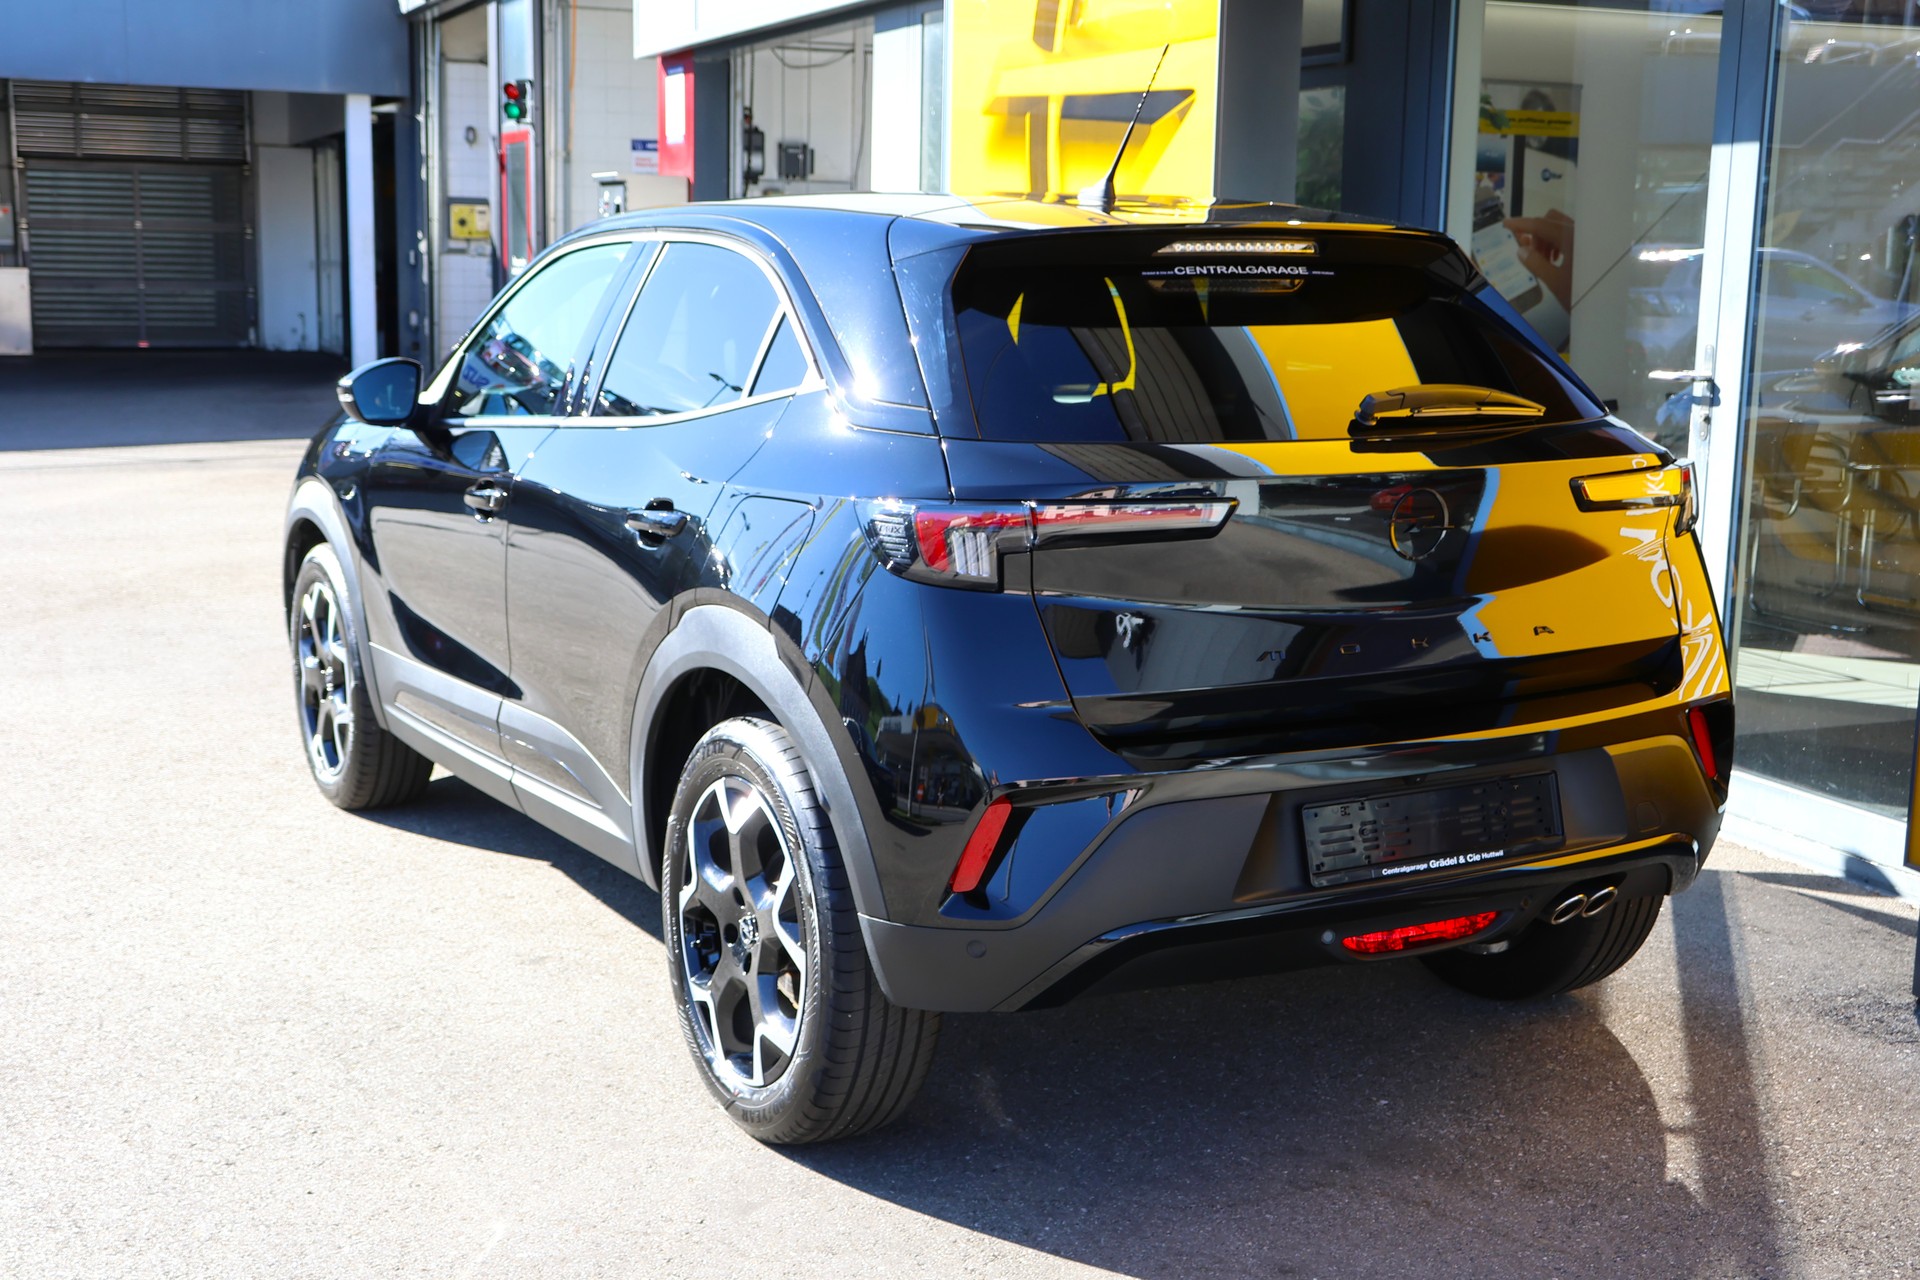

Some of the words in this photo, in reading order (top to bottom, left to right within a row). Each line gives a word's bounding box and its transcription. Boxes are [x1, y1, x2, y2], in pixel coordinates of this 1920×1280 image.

[1174, 265, 1309, 275] CENTRALGARAGE
[1256, 625, 1555, 663] MOKKA
[1381, 862, 1428, 876] Centralgarage
[1429, 856, 1458, 869] Grädel
[1458, 855, 1466, 864] &
[1466, 852, 1481, 863] Cie
[1481, 849, 1504, 860] Huttwil
